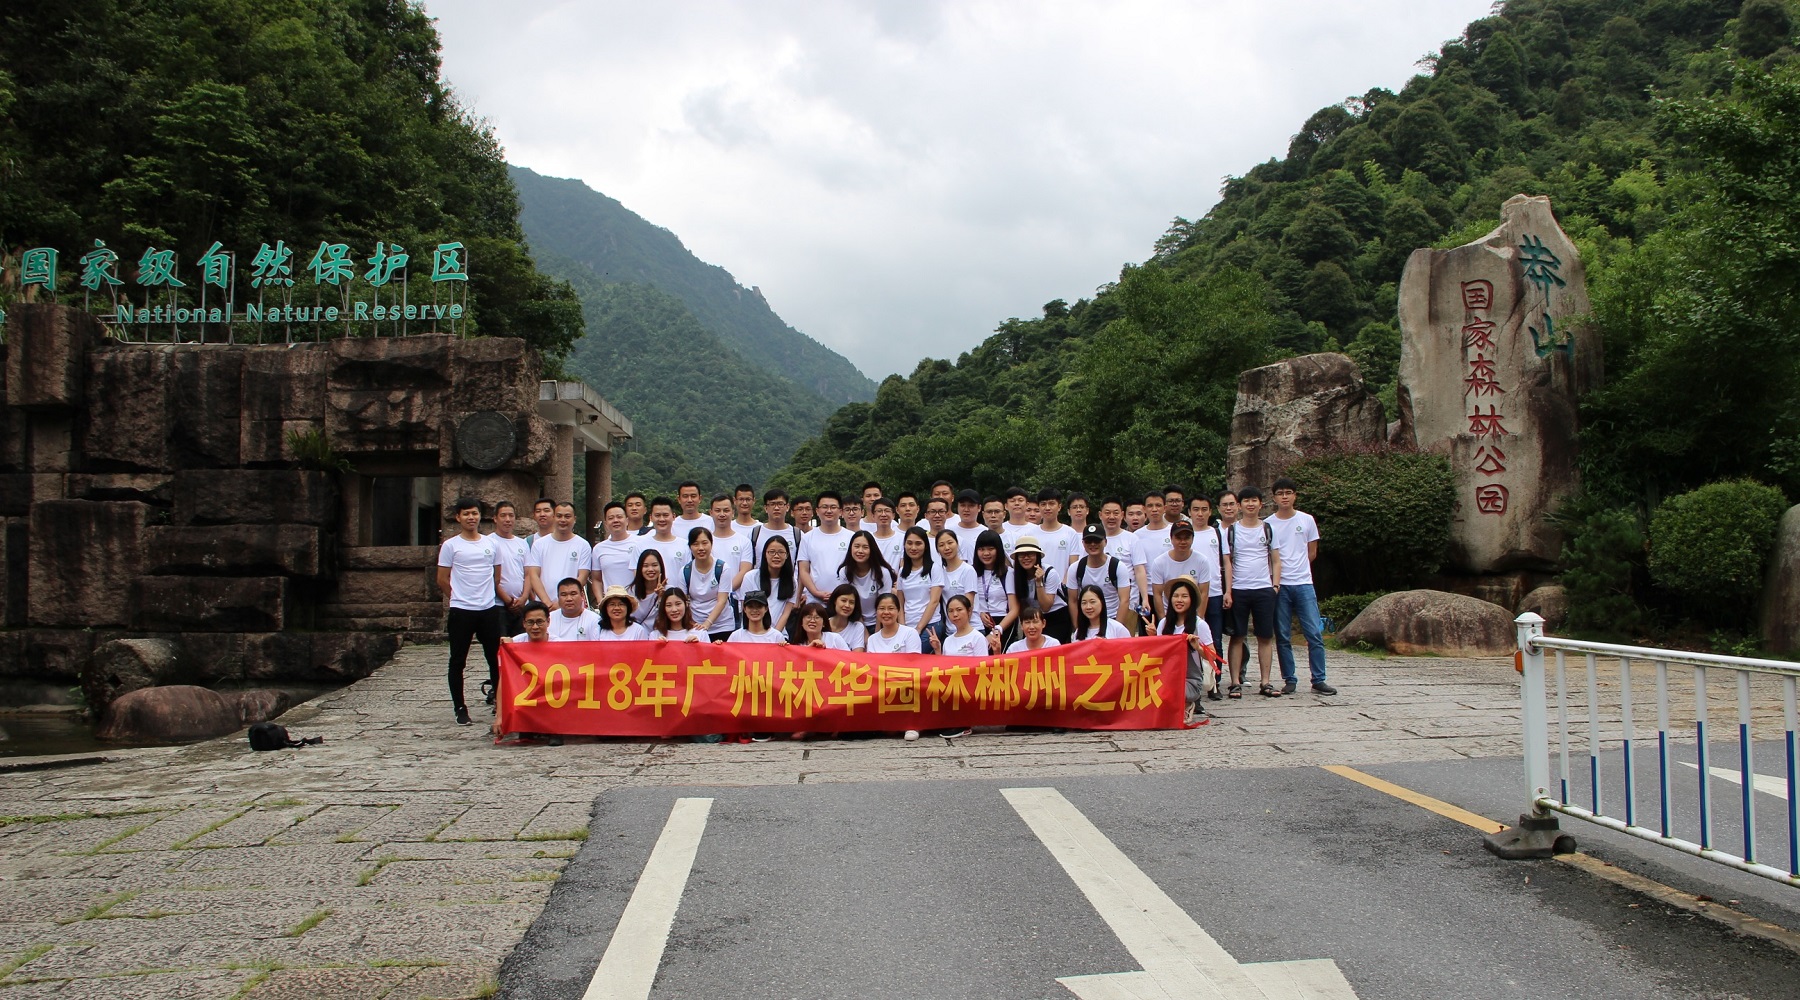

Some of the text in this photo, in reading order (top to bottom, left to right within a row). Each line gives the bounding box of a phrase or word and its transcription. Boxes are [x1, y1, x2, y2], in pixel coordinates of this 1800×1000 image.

[0, 239, 469, 291] 国家级自然保护区
[1518, 233, 1575, 362] 莽山
[117, 300, 464, 324] National Nature Reserve
[1461, 279, 1509, 516] 国家森林公园
[513, 653, 1164, 718] 2018年广州林华园林郴州之旅
